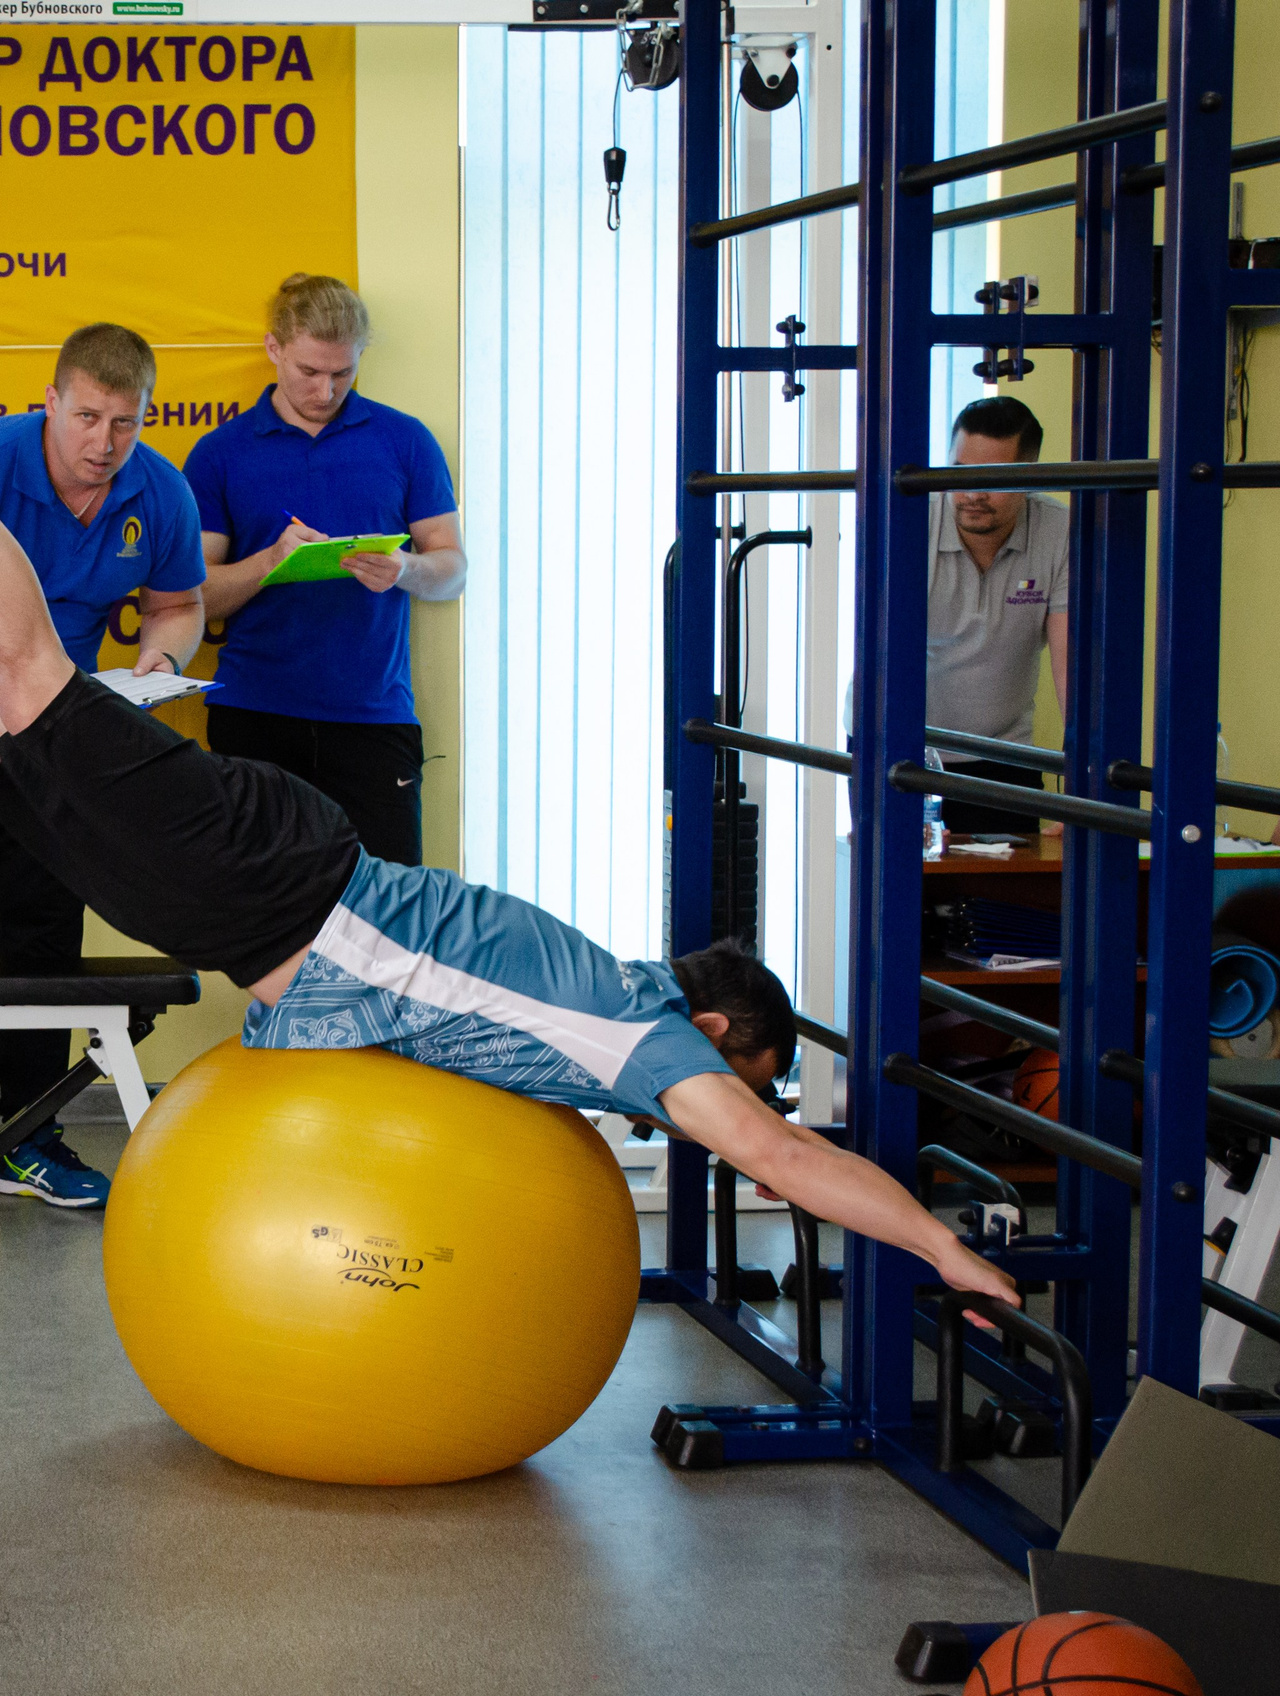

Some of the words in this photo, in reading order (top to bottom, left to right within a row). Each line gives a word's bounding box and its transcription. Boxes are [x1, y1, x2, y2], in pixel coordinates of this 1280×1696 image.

[21, 1, 103, 17] Бубновского
[38, 35, 314, 92] ДОКТОРА
[336, 1243, 424, 1273] CLASSIC
[343, 1271, 420, 1292] John
